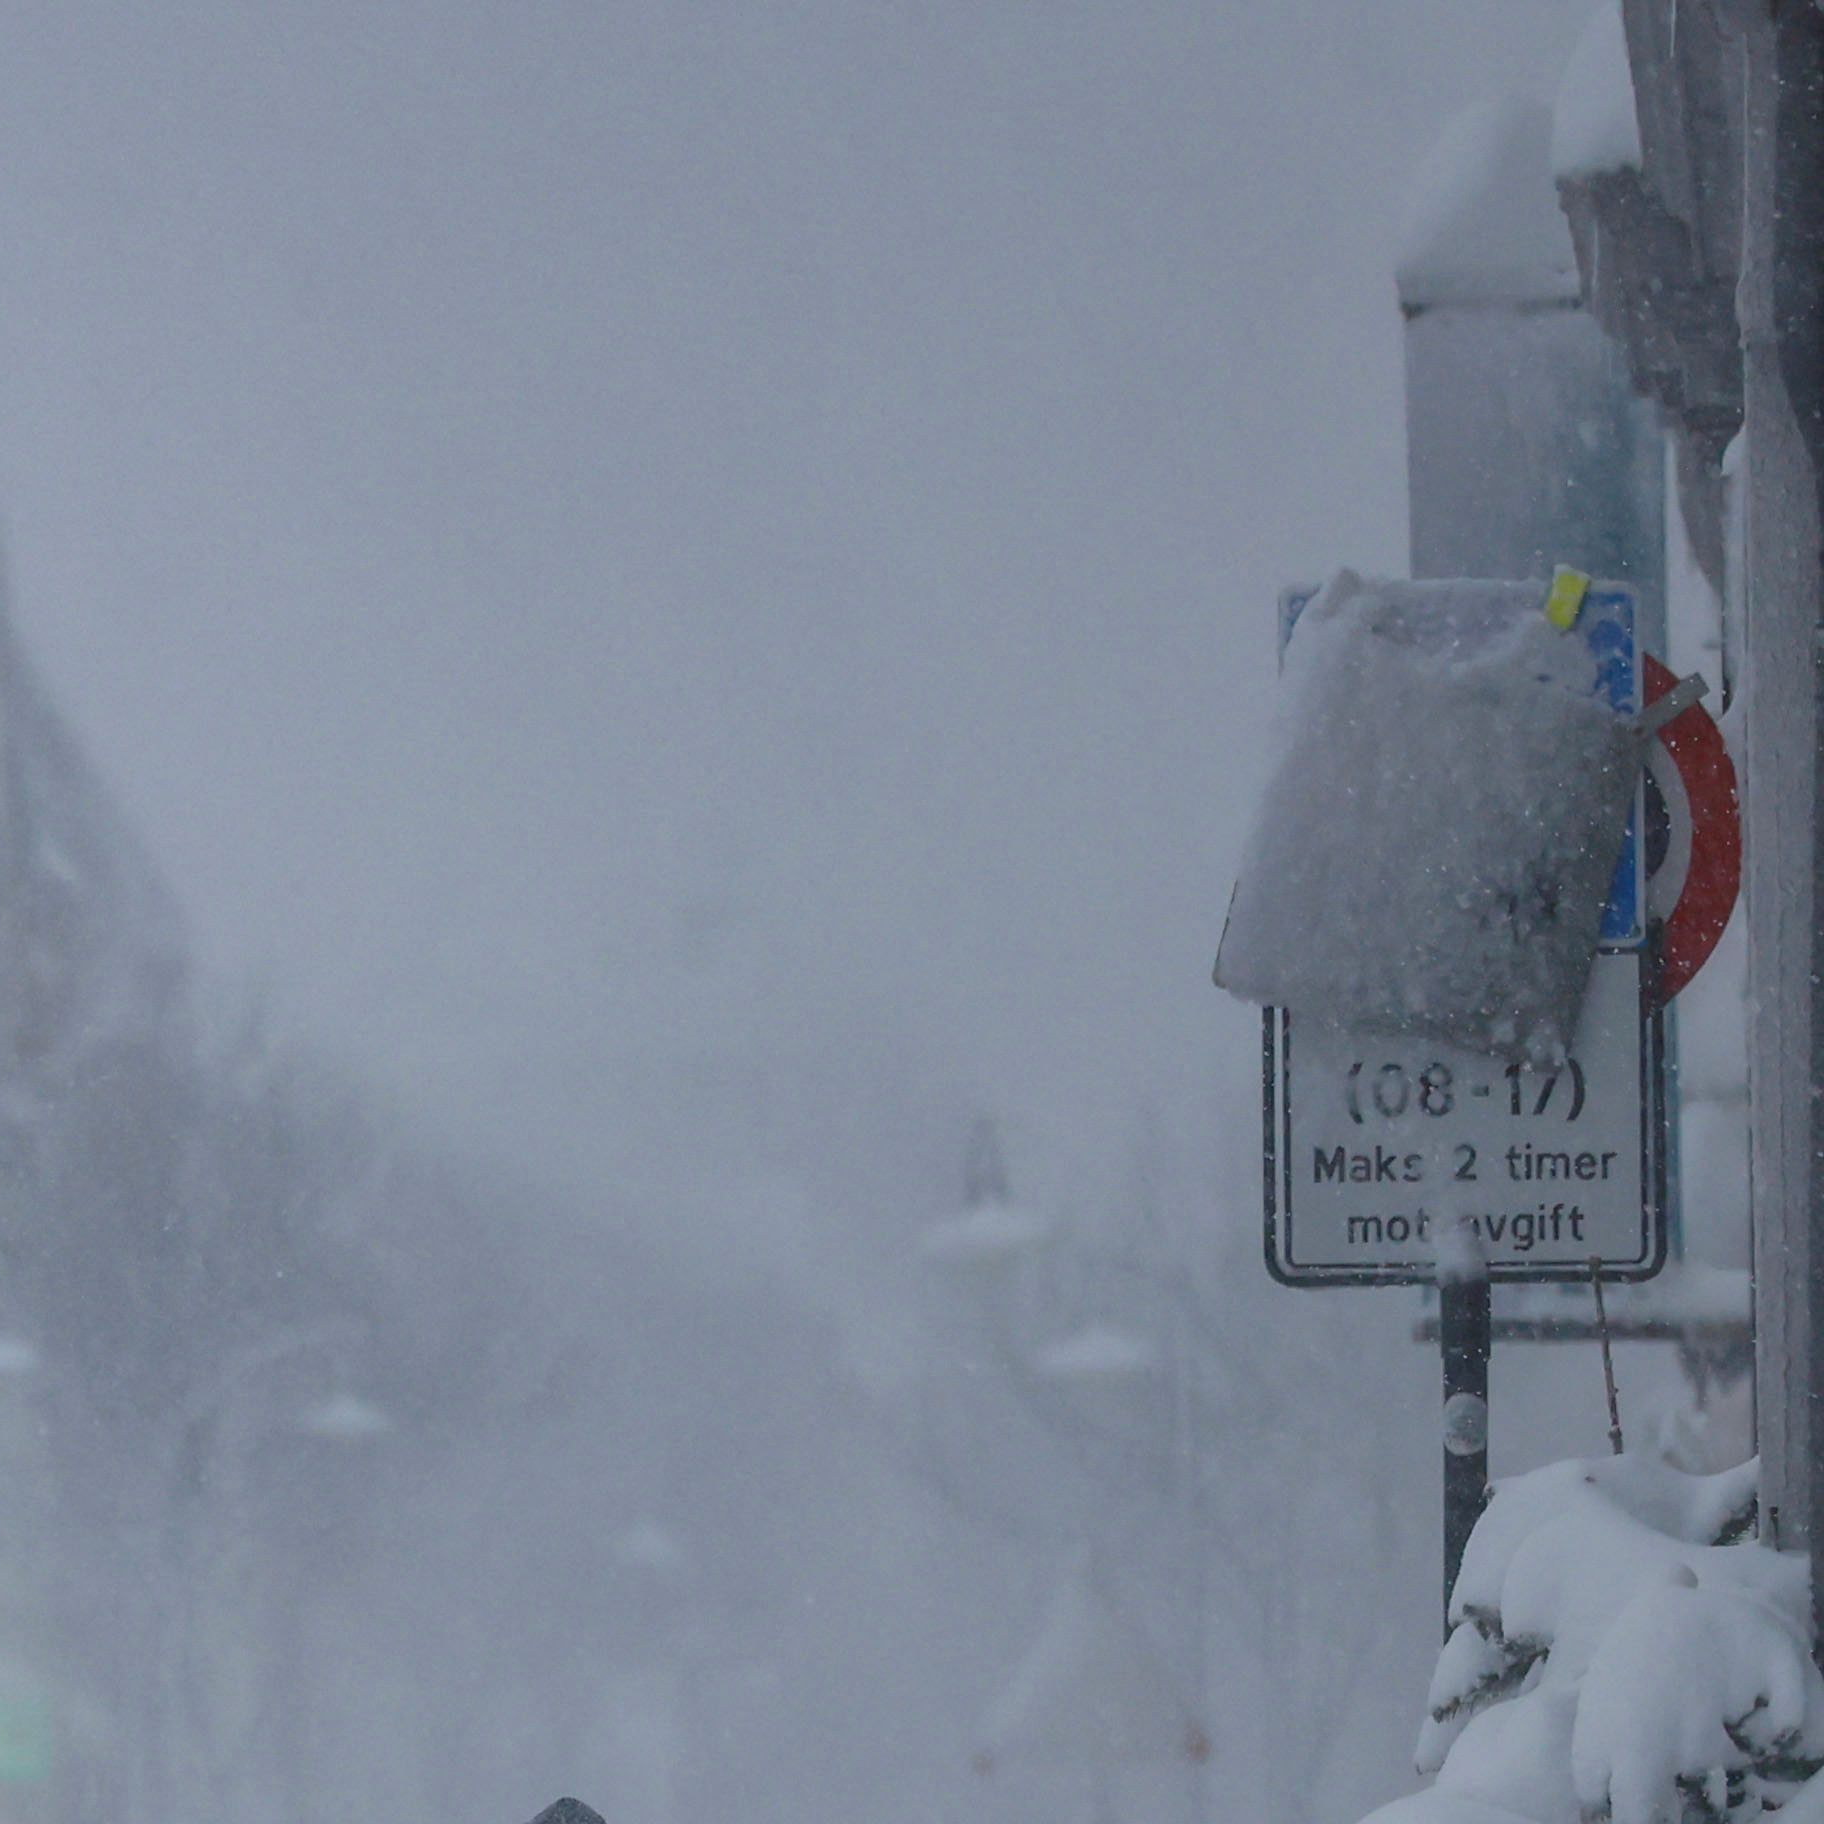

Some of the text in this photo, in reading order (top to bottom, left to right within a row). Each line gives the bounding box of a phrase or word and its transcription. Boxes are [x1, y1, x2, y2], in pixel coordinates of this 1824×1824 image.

[1313, 1143, 1618, 1183] Maks 2 timer
[1347, 1207, 1431, 1244] mot
